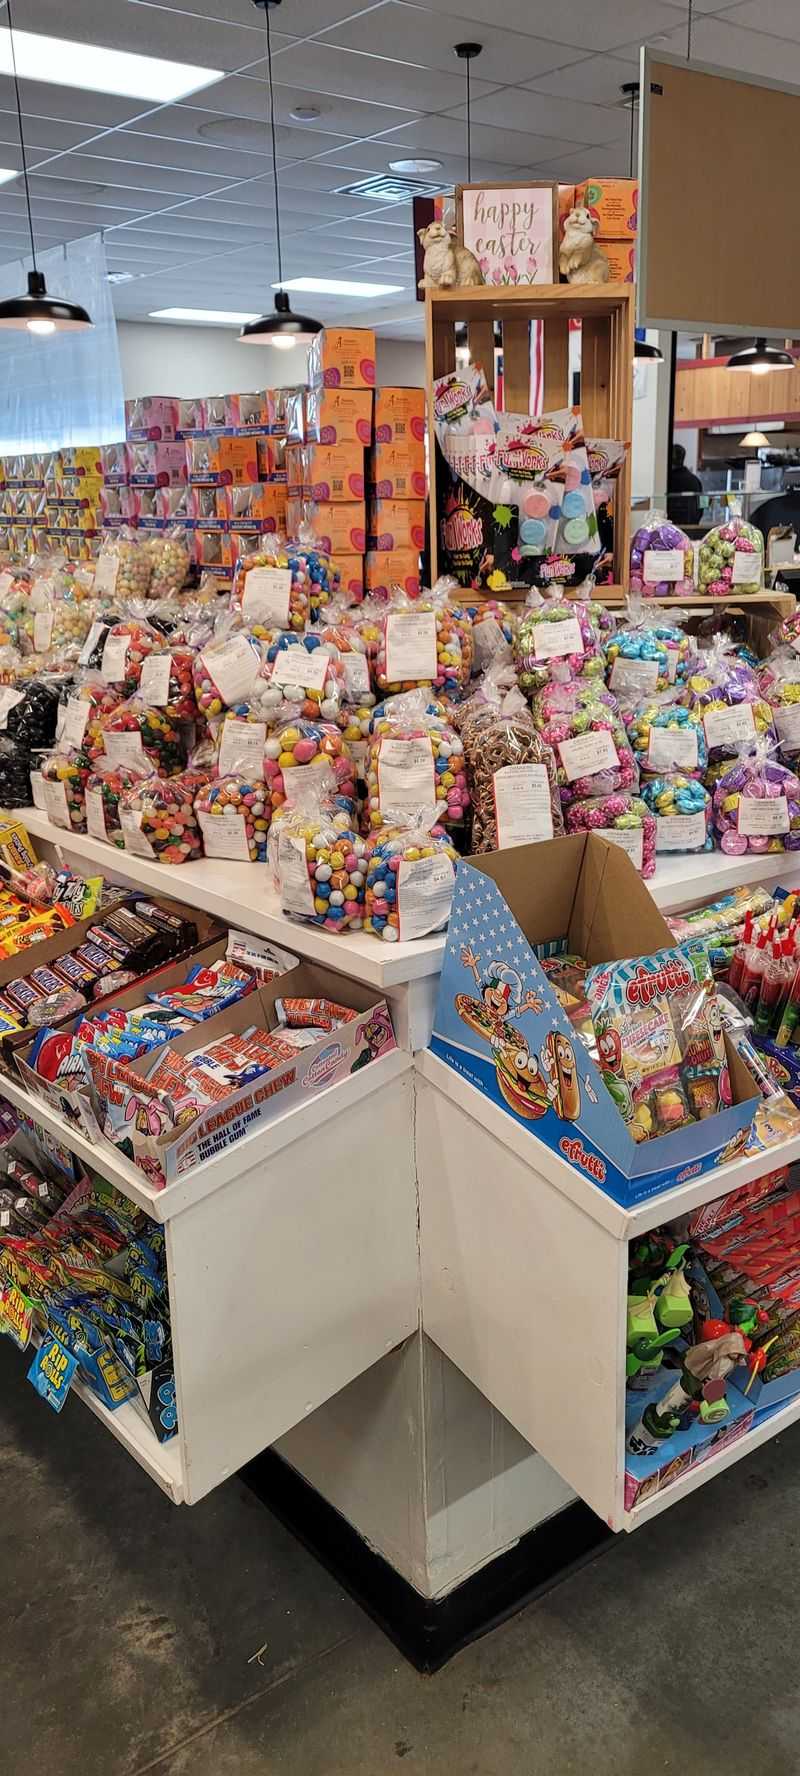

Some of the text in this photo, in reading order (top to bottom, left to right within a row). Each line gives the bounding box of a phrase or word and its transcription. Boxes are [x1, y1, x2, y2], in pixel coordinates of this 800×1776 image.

[473, 191, 540, 231] happy
[474, 230, 542, 257] easter
[198, 1093, 255, 1139] LEAGUE
[253, 1067, 298, 1105] CHEW
[197, 1107, 262, 1152] THE HALL OF FAME
[199, 1136, 228, 1162] BUBBLE
